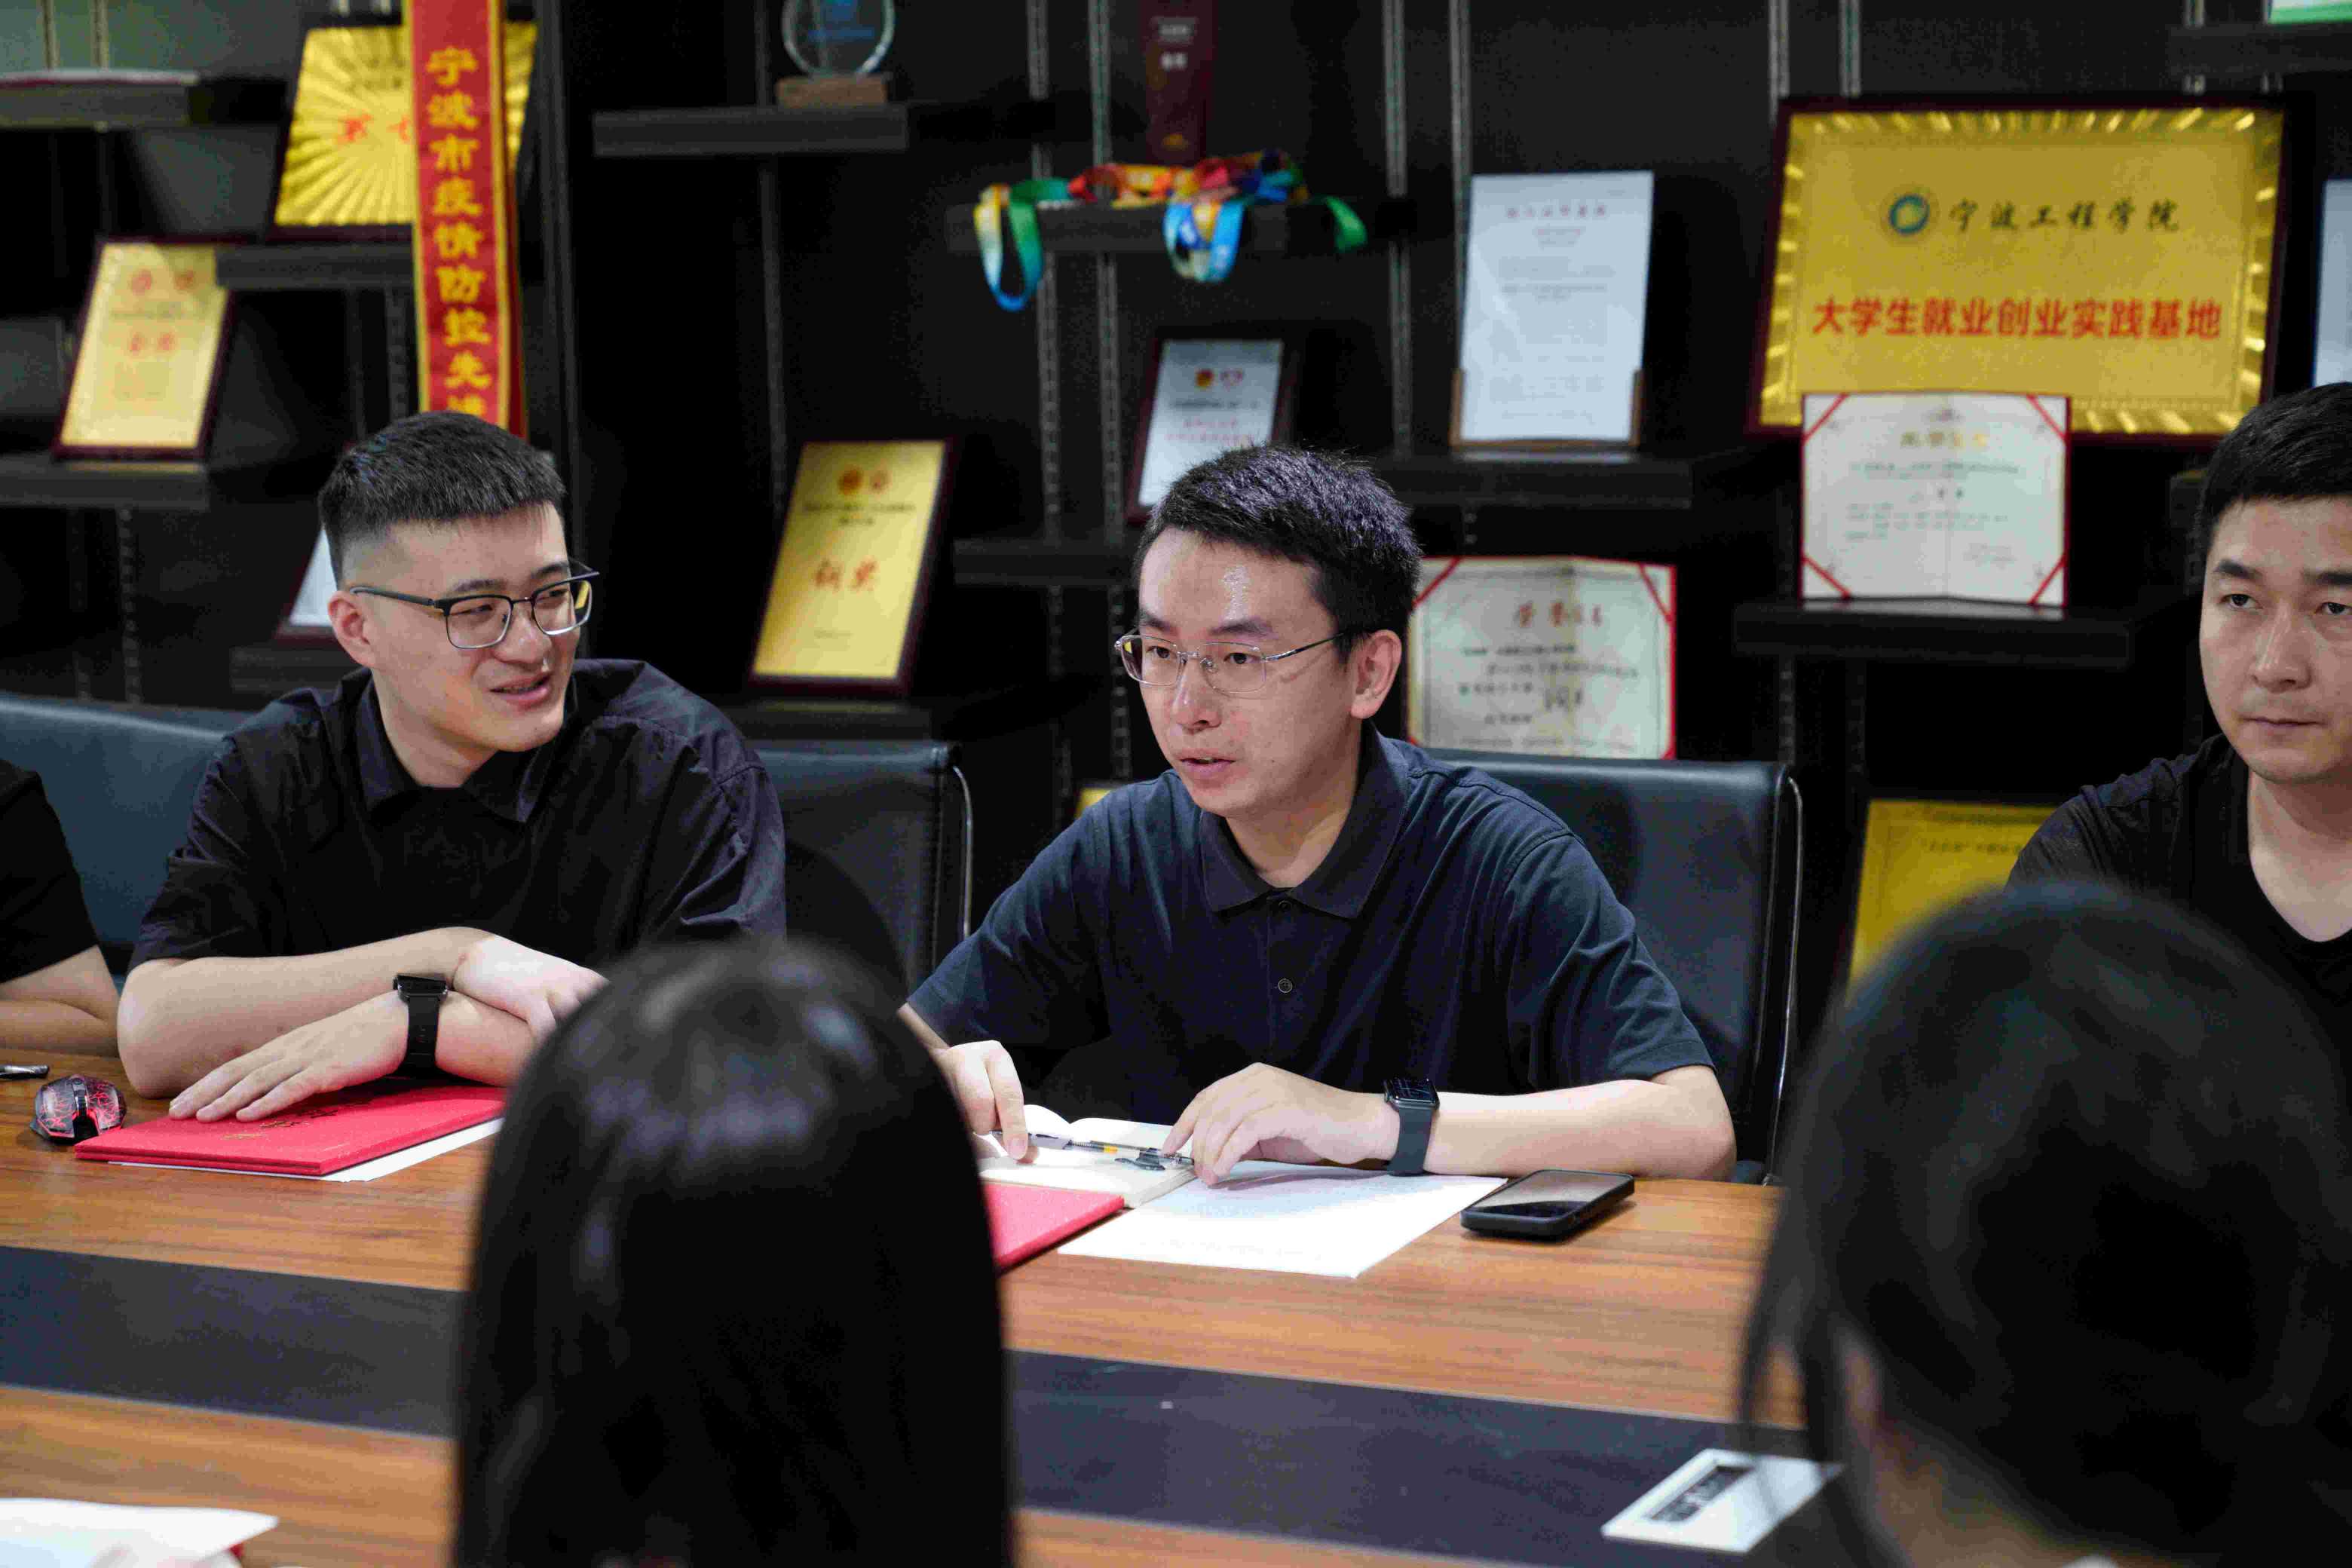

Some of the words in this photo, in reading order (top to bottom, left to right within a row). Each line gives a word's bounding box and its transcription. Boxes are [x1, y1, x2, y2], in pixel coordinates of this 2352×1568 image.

[1949, 195, 2182, 233] 宁波工程学院
[1811, 294, 2222, 341] 大学生就业创业实践基地
